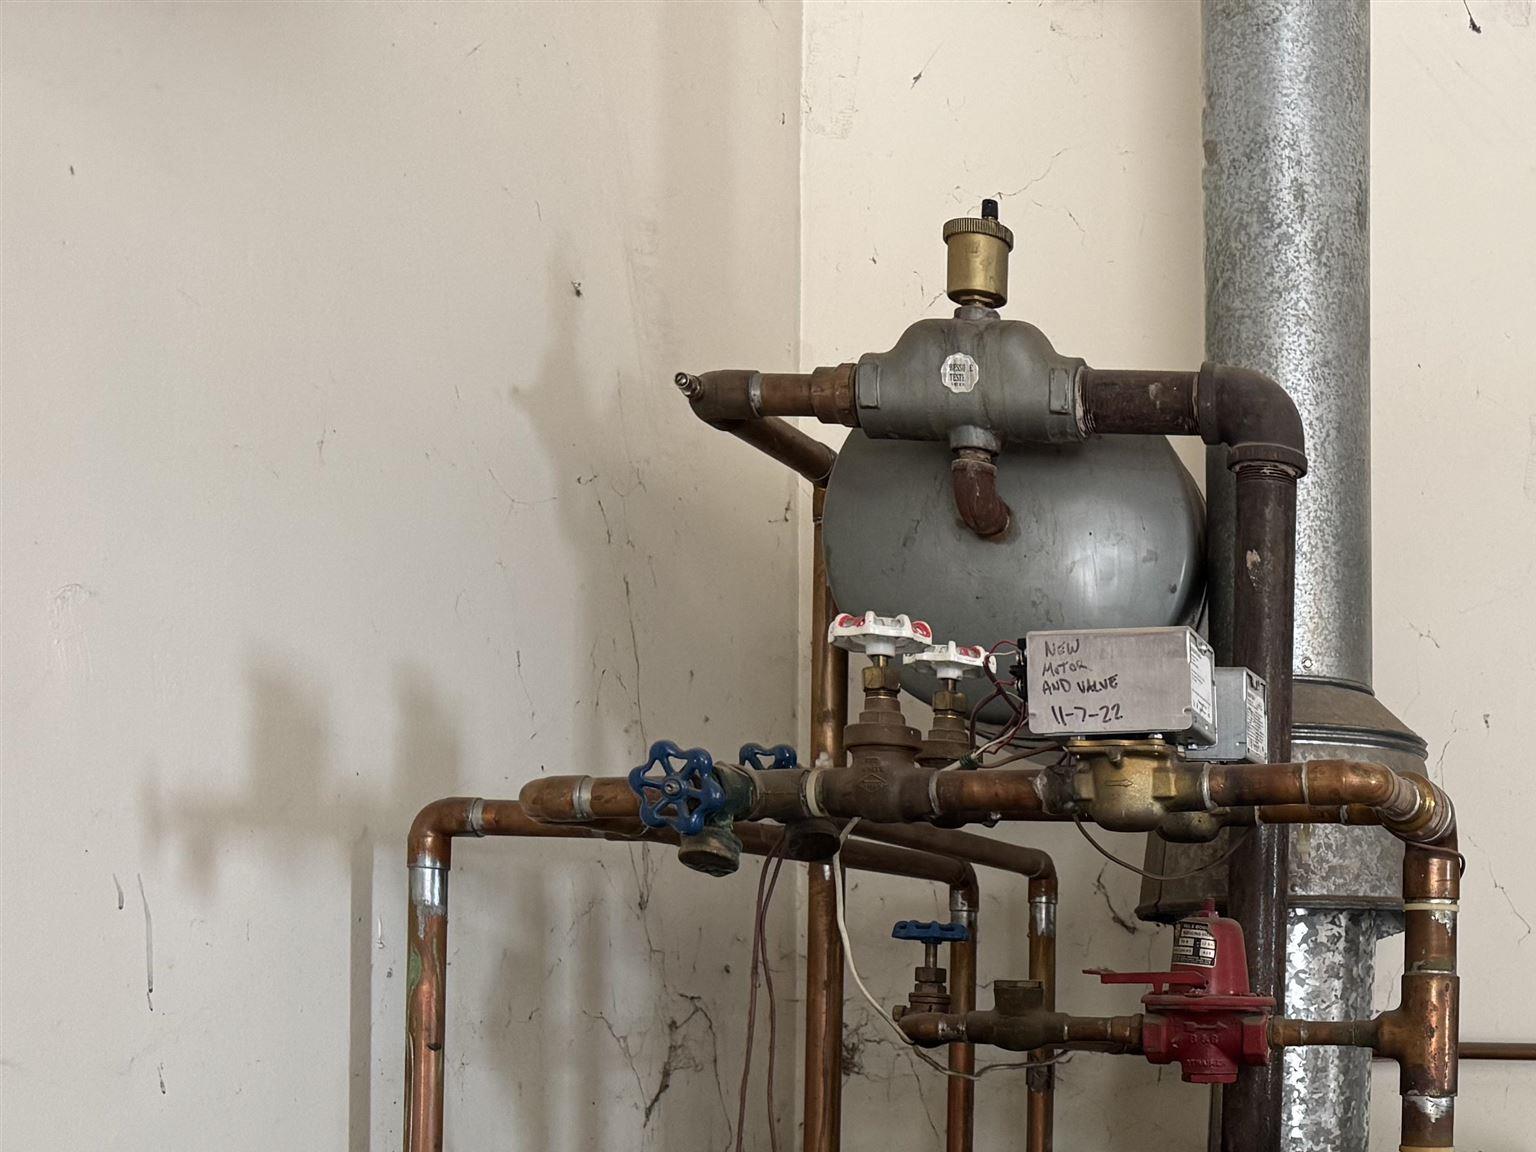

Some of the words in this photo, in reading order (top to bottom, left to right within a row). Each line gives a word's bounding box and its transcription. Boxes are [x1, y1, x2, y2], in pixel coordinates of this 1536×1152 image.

[1044, 638, 1080, 657] NEW
[1042, 678, 1072, 695] AND
[1076, 673, 1119, 694] VALVE
[1051, 703, 1123, 726] 11-7-22
